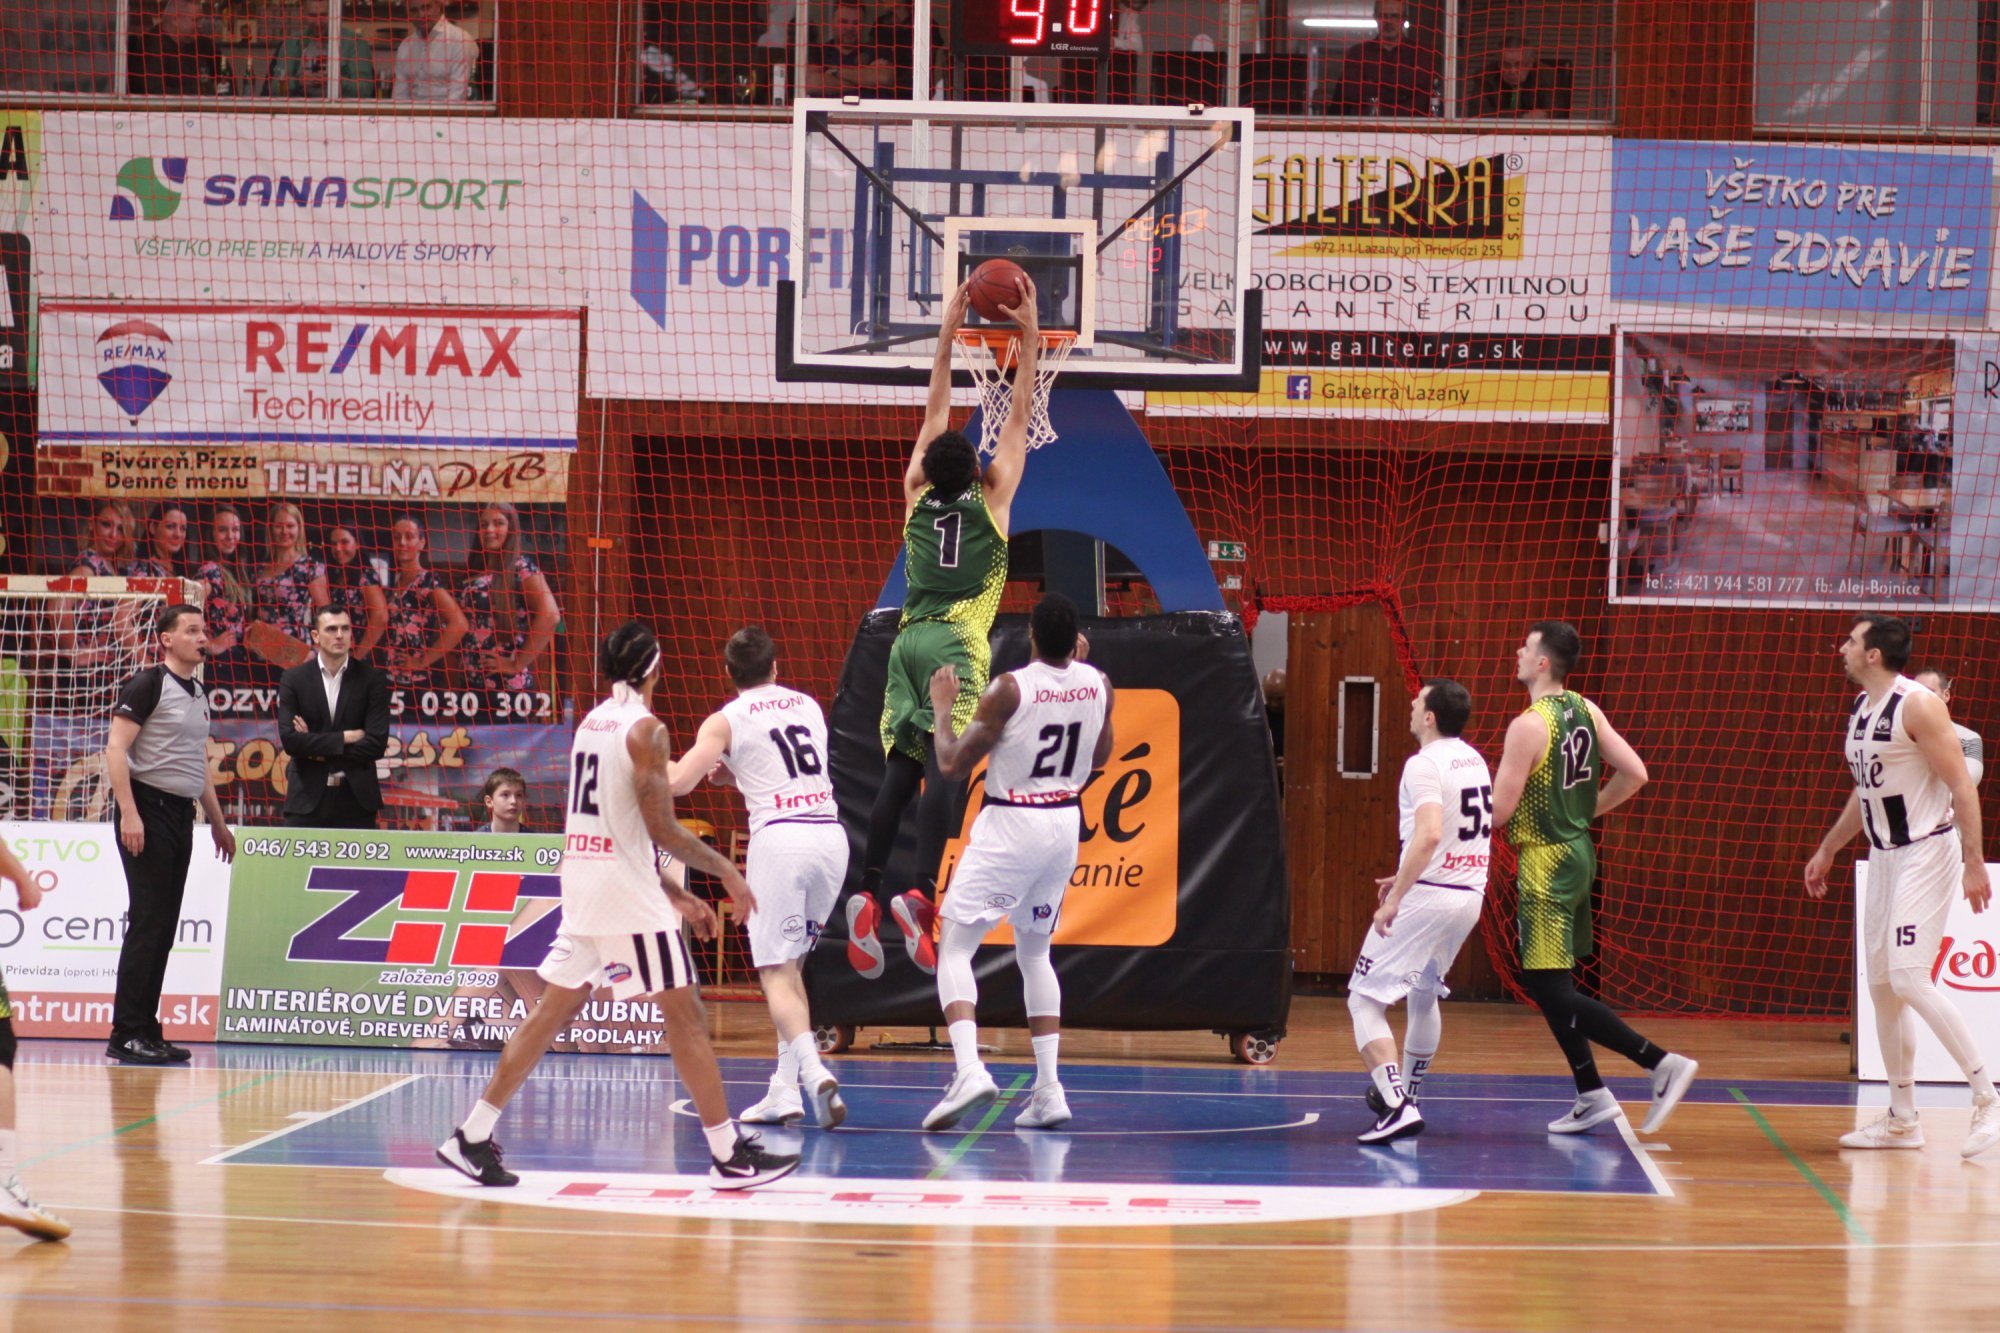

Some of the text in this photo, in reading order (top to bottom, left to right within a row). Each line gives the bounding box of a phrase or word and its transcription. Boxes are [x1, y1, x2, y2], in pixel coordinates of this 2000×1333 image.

[1050, 43, 1069, 51] LGR
[203, 175, 523, 211] SANASPORT
[1706, 157, 1898, 219] VŠETKO PRE
[133, 237, 496, 261] VŠETKO PRE BEH A HALOVÉ ŠPORTY
[1314, 242, 1335, 254] 972
[1340, 243, 1353, 254] 11
[1358, 243, 1400, 257] Lazany
[1404, 243, 1421, 258] pri
[1482, 245, 1505, 257] 255
[1628, 206, 1756, 270] VAŠE
[1403, 275, 1416, 294] S
[1428, 276, 1588, 296] TEXTILNOU
[103, 343, 166, 362] RE/MAX
[245, 321, 523, 378] RE/MAX
[1322, 383, 1399, 400] Galterra
[1406, 385, 1470, 404] Lazany
[243, 388, 434, 430] Techreality
[105, 470, 249, 490] Denné menu
[263, 460, 440, 497] TEHELŇA
[934, 512, 961, 568] 1
[1714, 576, 1741, 591] 944
[1747, 576, 1771, 592] 581
[1777, 577, 1804, 592] 777
[1838, 578, 1920, 597] Alej-Bojnice
[421, 692, 480, 717] 030
[496, 692, 553, 718] 302
[750, 695, 805, 715] ANTONI
[1032, 686, 1099, 704] JOHNSON
[769, 724, 822, 780] 16
[1029, 721, 1082, 778] 21
[1561, 727, 1592, 790] 12
[572, 751, 600, 816] 12
[1458, 785, 1493, 841] 55
[243, 838, 291, 858] 046/
[293, 841, 331, 859] 543
[335, 842, 361, 859] 20
[365, 843, 390, 860] 92
[405, 845, 524, 864] www.zplusz.sk
[1896, 925, 1916, 947] 15
[6, 964, 60, 977] Prievidza
[64, 966, 99, 978] (oproti
[379, 968, 498, 988] založené 1998
[1355, 955, 1374, 976] 55
[226, 987, 407, 1016] INTERIÉROVÉ
[413, 995, 503, 1019] DVERE
[509, 999, 528, 1020] A
[225, 1014, 356, 1038] LAMINÁTOVÉ,
[360, 1020, 449, 1039] DREVENÉ
[453, 1024, 467, 1040] A
[570, 1027, 664, 1045] PODLAHY
